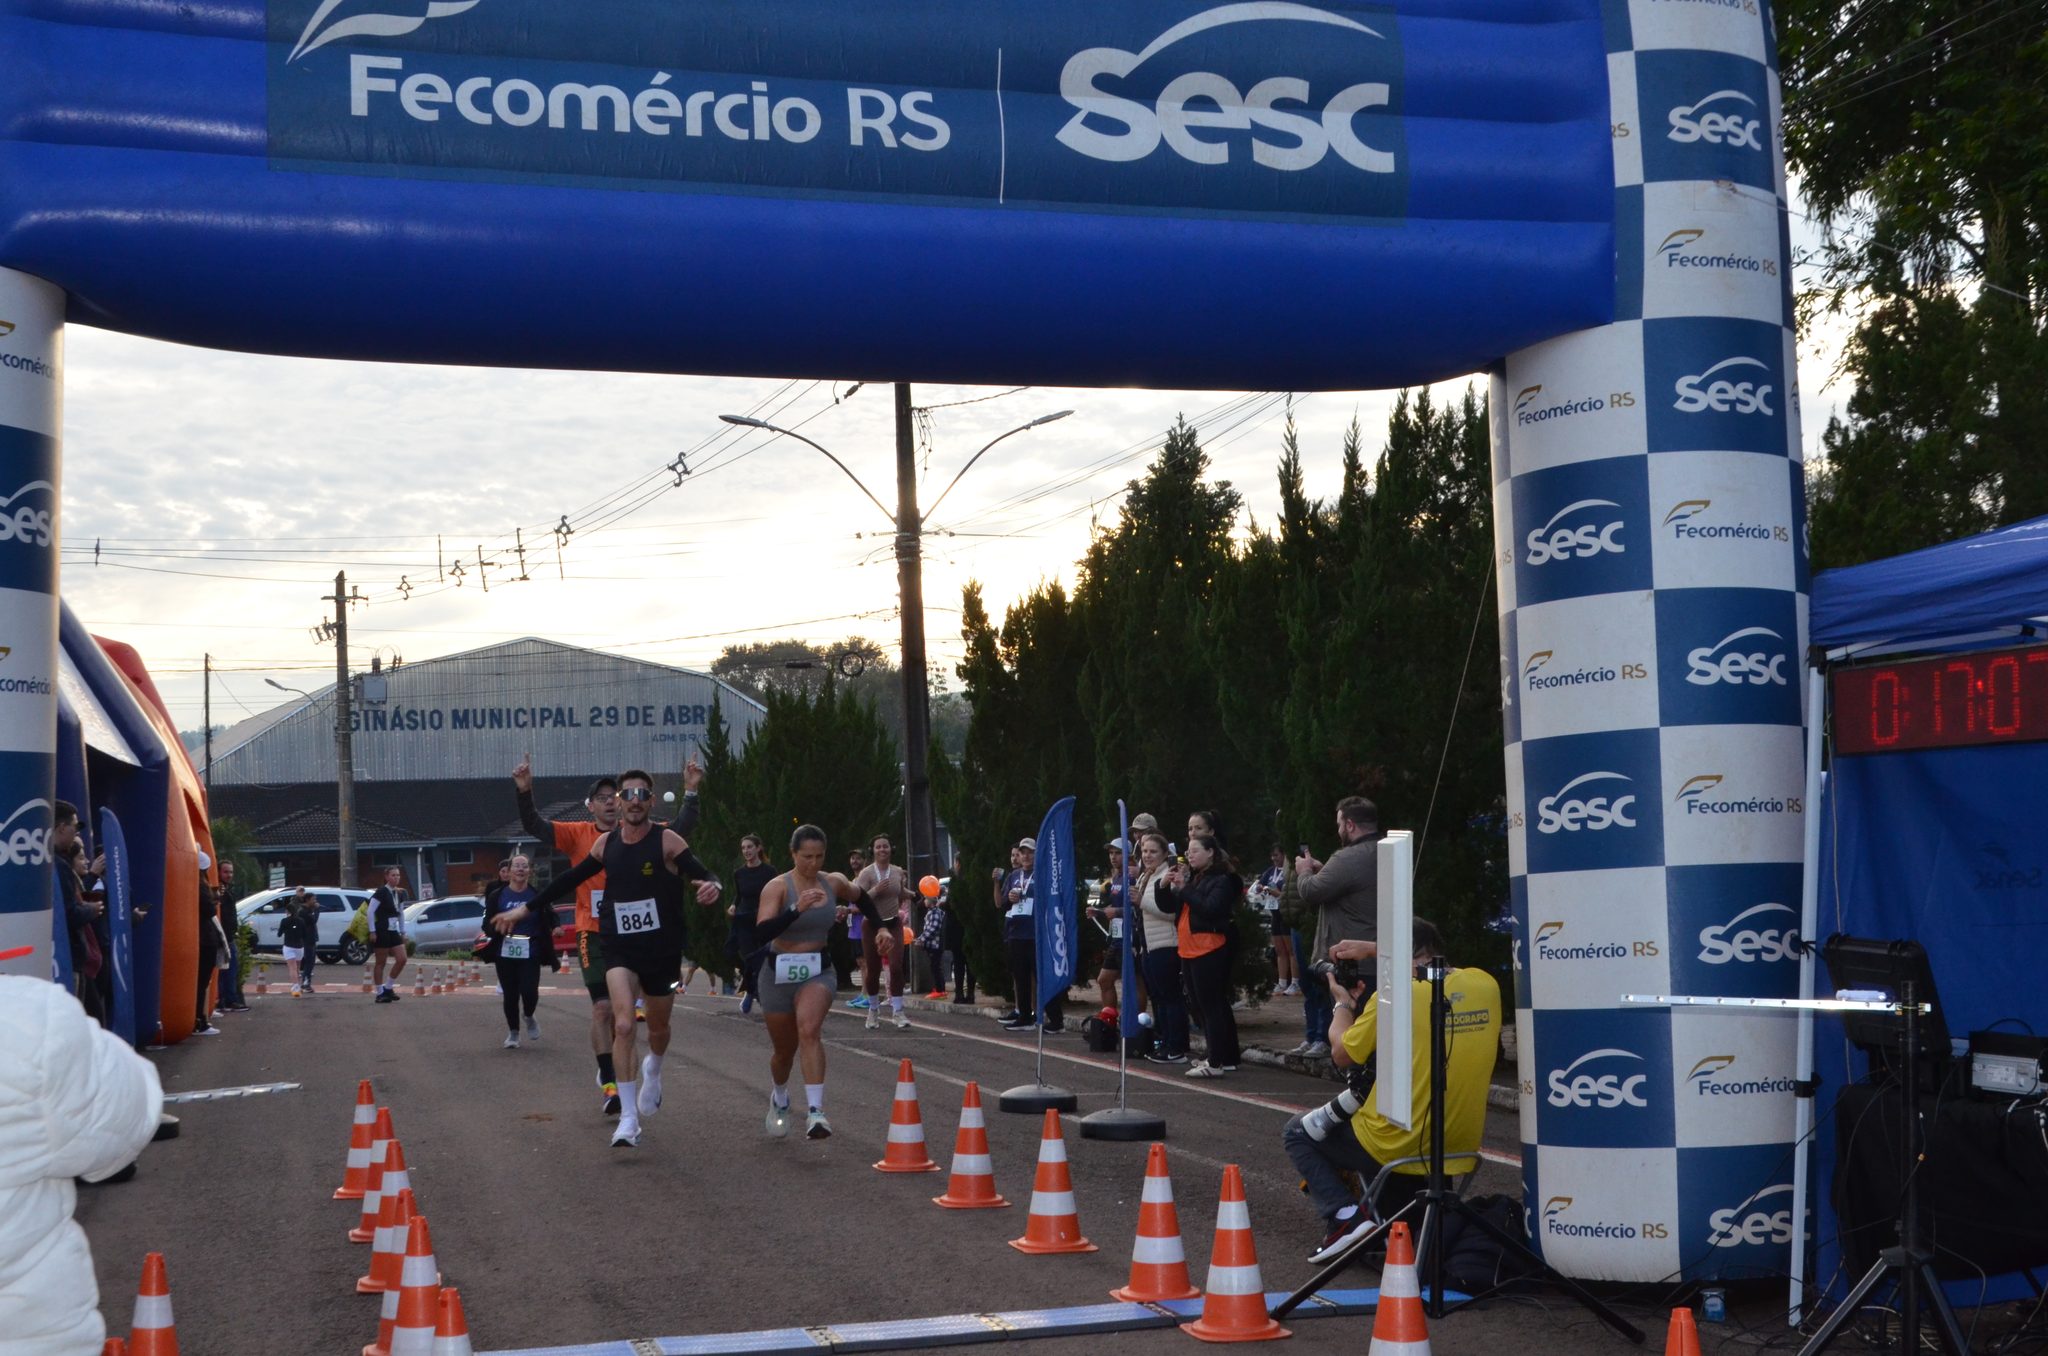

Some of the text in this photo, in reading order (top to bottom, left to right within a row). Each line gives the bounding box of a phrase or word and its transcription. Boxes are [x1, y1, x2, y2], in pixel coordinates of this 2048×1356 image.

[350, 38, 1395, 173] Fecomércio RS Sesc
[1667, 100, 1762, 151] Sesc
[1668, 251, 1777, 276] Fecomércio RS
[1673, 366, 1773, 416] Sesc
[1517, 391, 1636, 427] Fecomércio RS
[1526, 511, 1625, 566] Sesc
[1675, 523, 1770, 540] Fecomércio
[1773, 526, 1789, 542] RS
[1529, 663, 1648, 691] Fecomércio RS
[1685, 640, 1786, 686] Sesc
[452, 707, 582, 730] MUNICIPAL
[589, 705, 619, 727] 29
[626, 705, 655, 727] DE
[1537, 795, 1636, 834] Sesc
[1687, 797, 1802, 815] Fecomércio RS
[621, 911, 654, 931] 884
[508, 945, 522, 956] 90
[1053, 906, 1069, 977] Sesc
[1539, 943, 1627, 960] Fecomércio
[1632, 941, 1659, 957] RS
[1697, 921, 1801, 965] Sesc
[788, 965, 809, 981] 59
[1547, 1064, 1647, 1108] Sesc
[1699, 1077, 1796, 1095] Fecomércio
[1548, 1218, 1636, 1239] Fecomércio
[1641, 1223, 1668, 1239] RS
